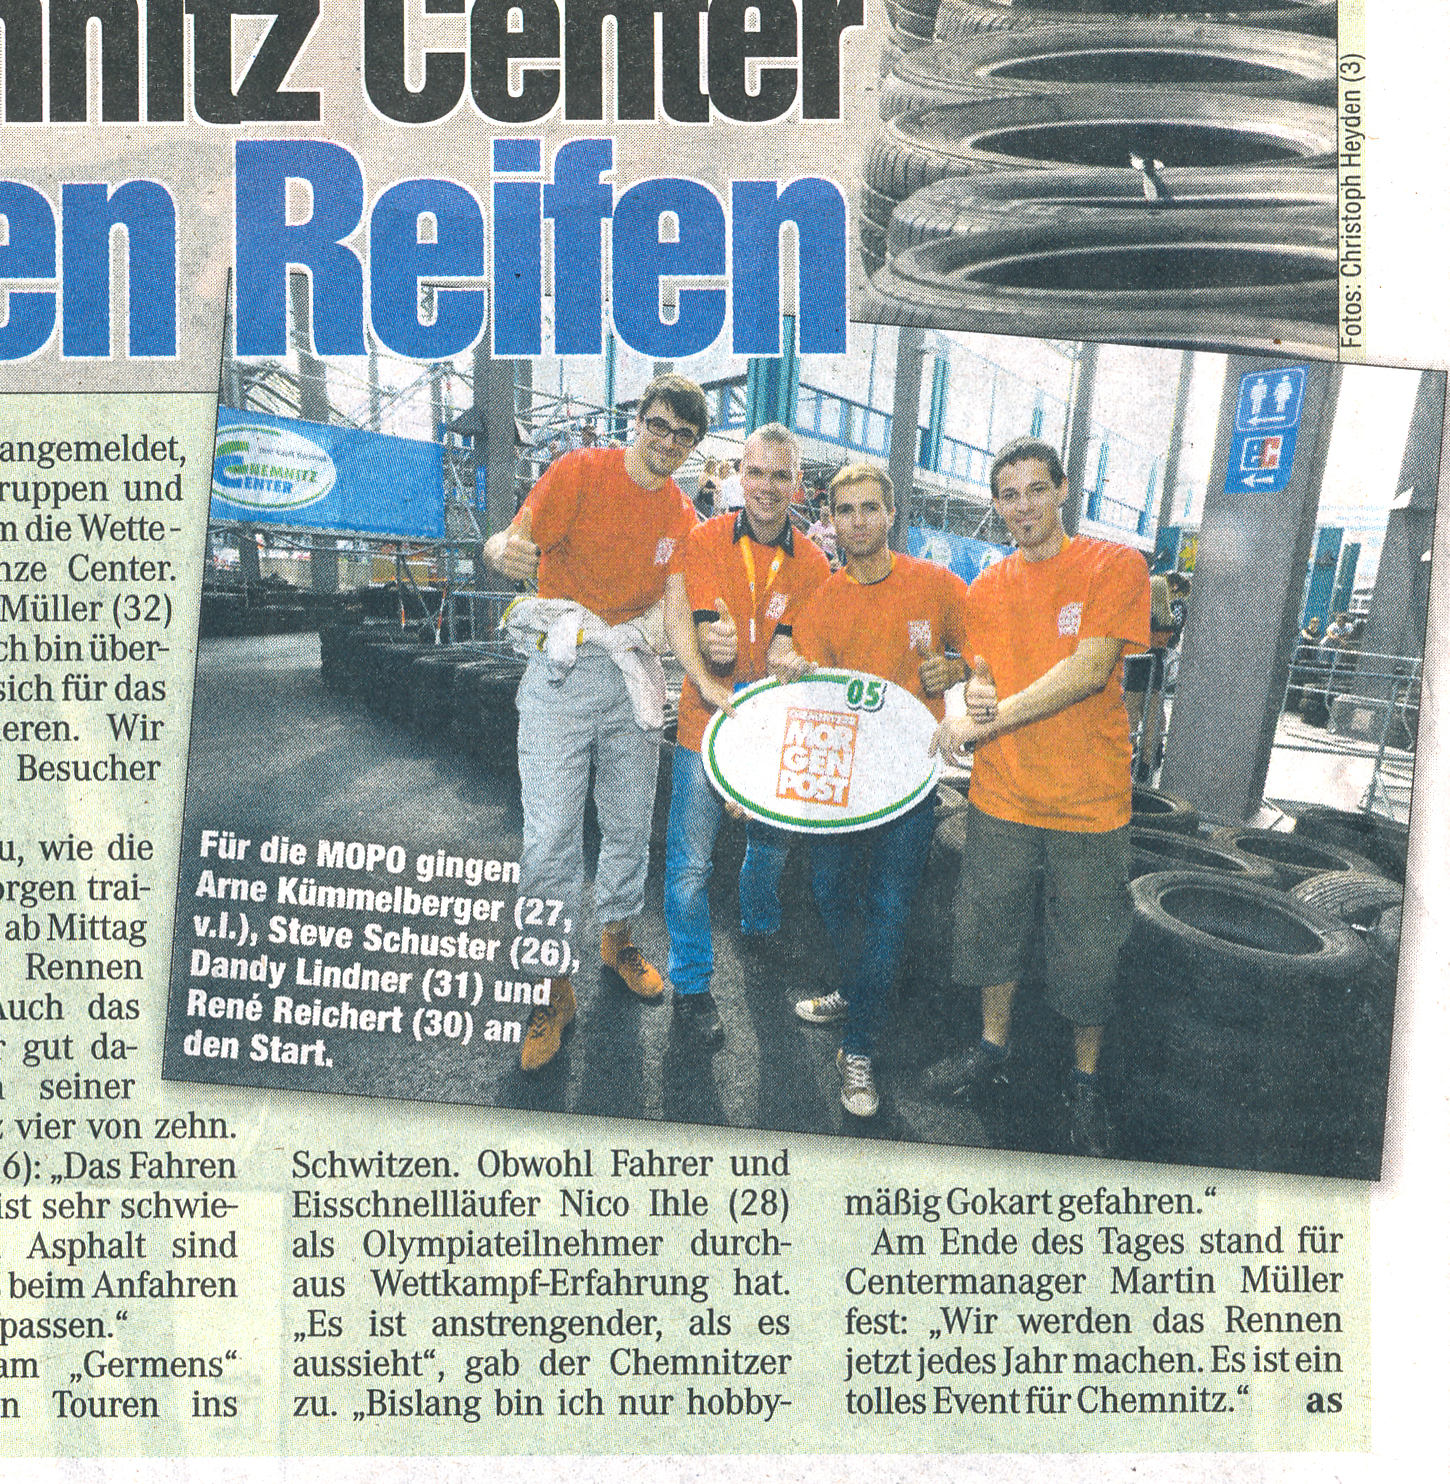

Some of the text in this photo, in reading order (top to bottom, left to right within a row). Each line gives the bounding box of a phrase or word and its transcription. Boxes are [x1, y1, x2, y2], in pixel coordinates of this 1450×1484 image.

[1339, 53, 1366, 348] Fotos: Christoph Heyden (3)
[234, 137, 848, 361] Reifen
[0, 594, 104, 623] Müller
[112, 593, 172, 629] (32)
[847, 678, 883, 707] 05
[106, 713, 165, 741] Wir
[785, 721, 853, 753] MOR
[782, 746, 852, 778] GEN
[778, 770, 849, 803] POST
[199, 830, 521, 884] Für die MOPO gingen
[195, 870, 573, 933] Arne Kümmelberger (27,
[193, 913, 580, 974] v.l.), Steve Schuster (26),
[25, 952, 143, 981] Rennen
[190, 949, 552, 1006] Dandy Lindner (31) und
[187, 989, 522, 1045] René Reichert (30) an
[22, 1034, 74, 1068] gut
[90, 1032, 138, 1060] da-
[183, 1029, 334, 1068] den Start.
[292, 1188, 789, 1224] Eisschnellläufer Nico Ihle (28)
[845, 1186, 1217, 1223] mäßig Gokart gefahren.“
[292, 1267, 790, 1304] aus Wettkampf-Erfahrung hat.
[845, 1265, 1344, 1302] Centermanager Martin Müller
[70, 1350, 237, 1383] „Germens“
[293, 1347, 792, 1384] aussieht“, gab der Chemnitzer
[845, 1384, 1343, 1415] tolles Event für Chemnitz.“ as
